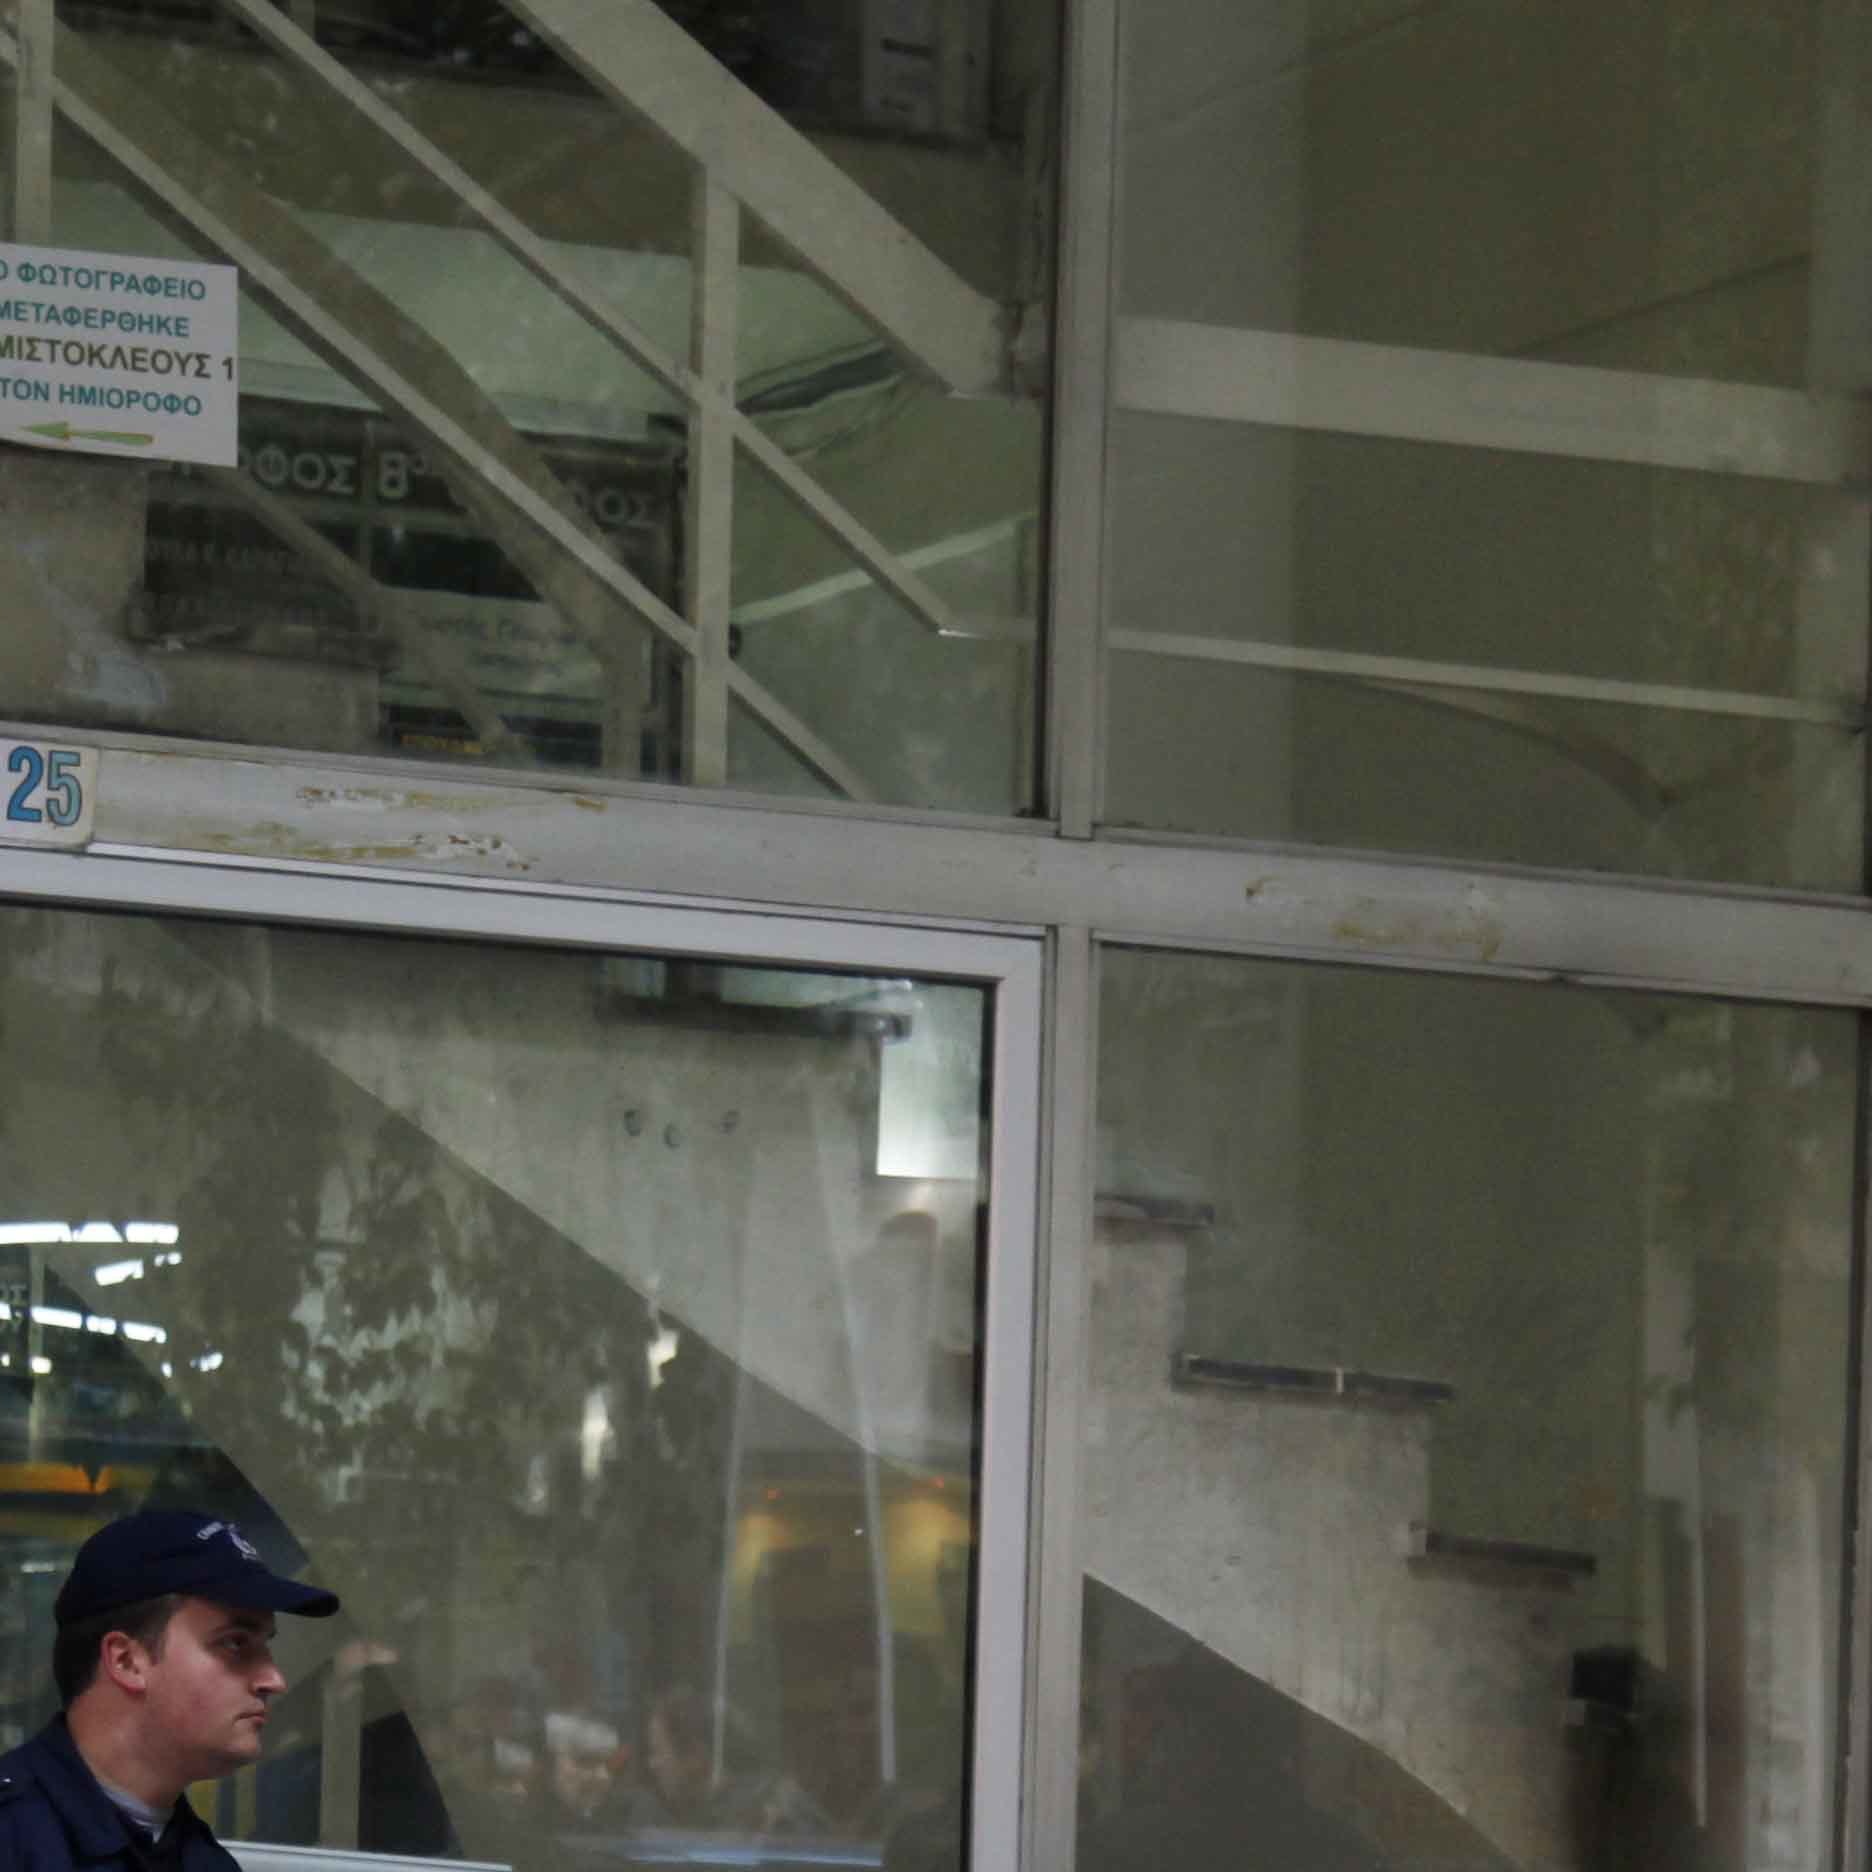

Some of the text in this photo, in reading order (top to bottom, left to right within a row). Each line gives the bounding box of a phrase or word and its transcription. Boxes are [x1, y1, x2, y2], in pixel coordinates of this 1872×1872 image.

[16, 262, 206, 301] ΦΩΤΟΓΡΑΦΕΙΟ
[58, 382, 203, 418] ΗΜΙΟΡΟΦΟ
[5, 746, 84, 828] 25
